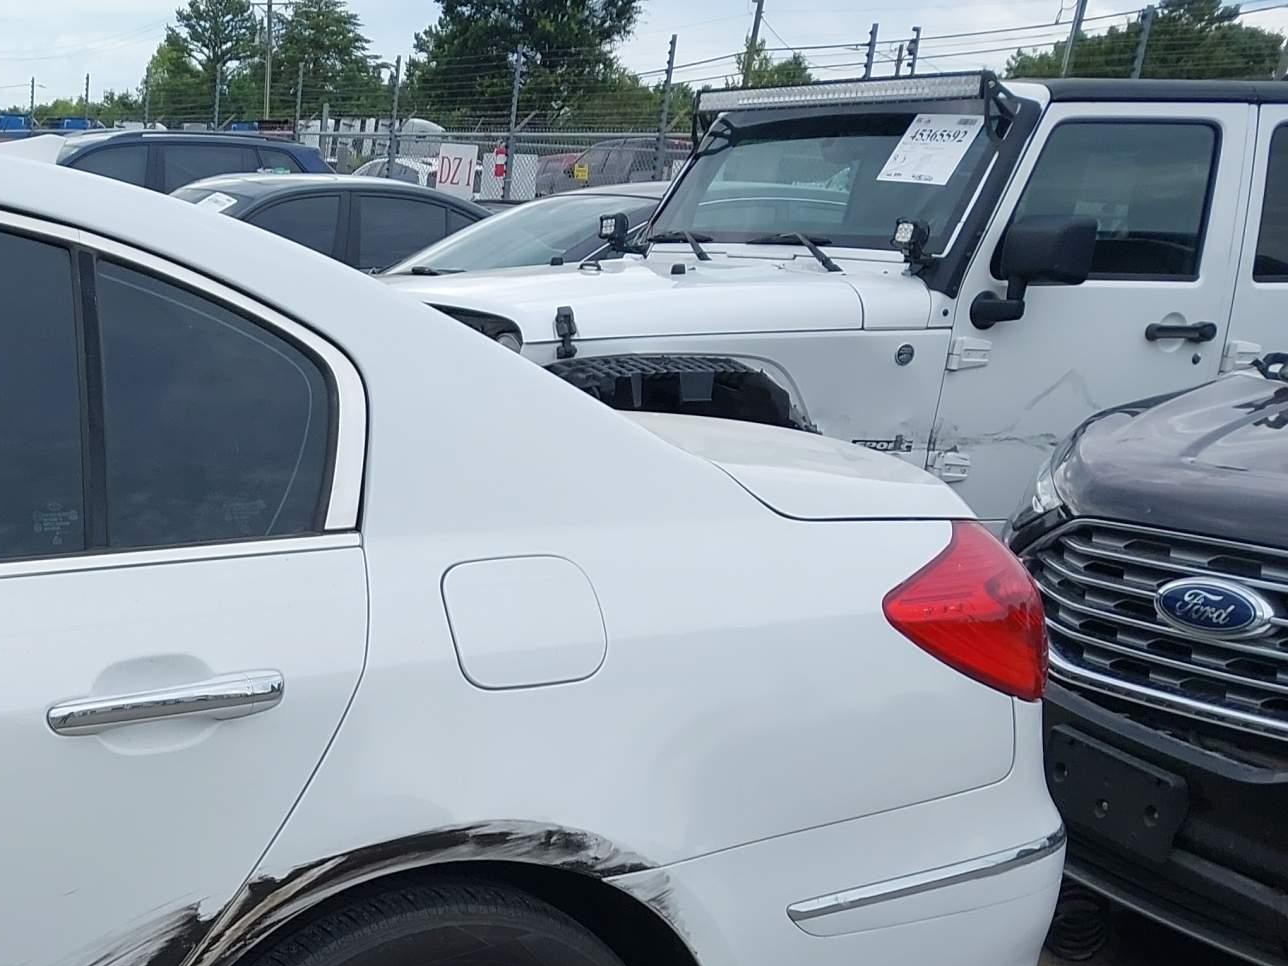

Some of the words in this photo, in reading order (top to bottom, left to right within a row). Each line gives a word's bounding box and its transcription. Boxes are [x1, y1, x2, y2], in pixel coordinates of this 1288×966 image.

[438, 156, 462, 185] DZ
[466, 158, 473, 186] 1
[1175, 589, 1235, 625] Ford
